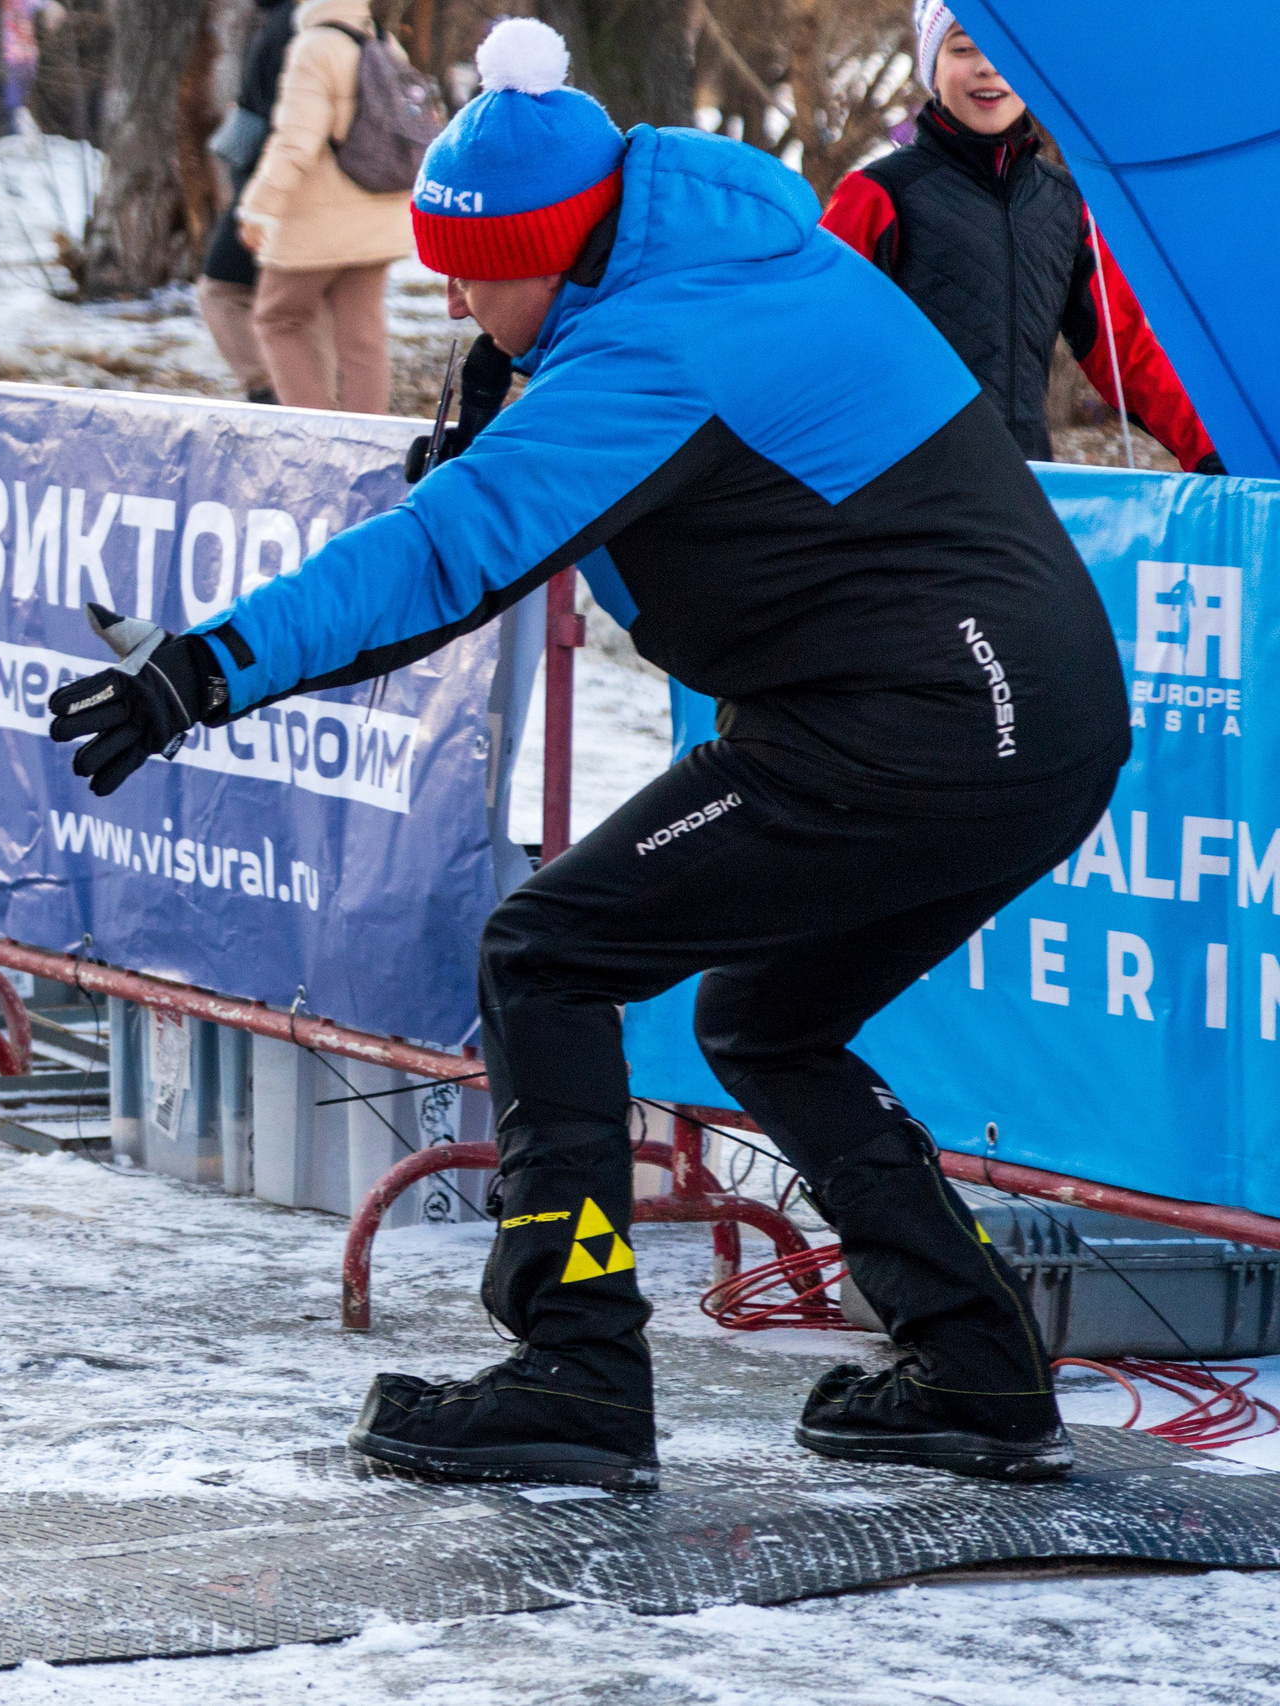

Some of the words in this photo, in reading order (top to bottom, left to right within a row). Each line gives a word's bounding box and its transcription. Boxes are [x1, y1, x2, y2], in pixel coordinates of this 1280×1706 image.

[958, 617, 1017, 757] NORDSKI
[1130, 706, 1242, 737] ASIA
[1132, 680, 1241, 711] EUROPE
[50, 809, 319, 911] www.visural.ru
[635, 791, 743, 856] NORDSKI
[1053, 806, 1280, 916] ALFM
